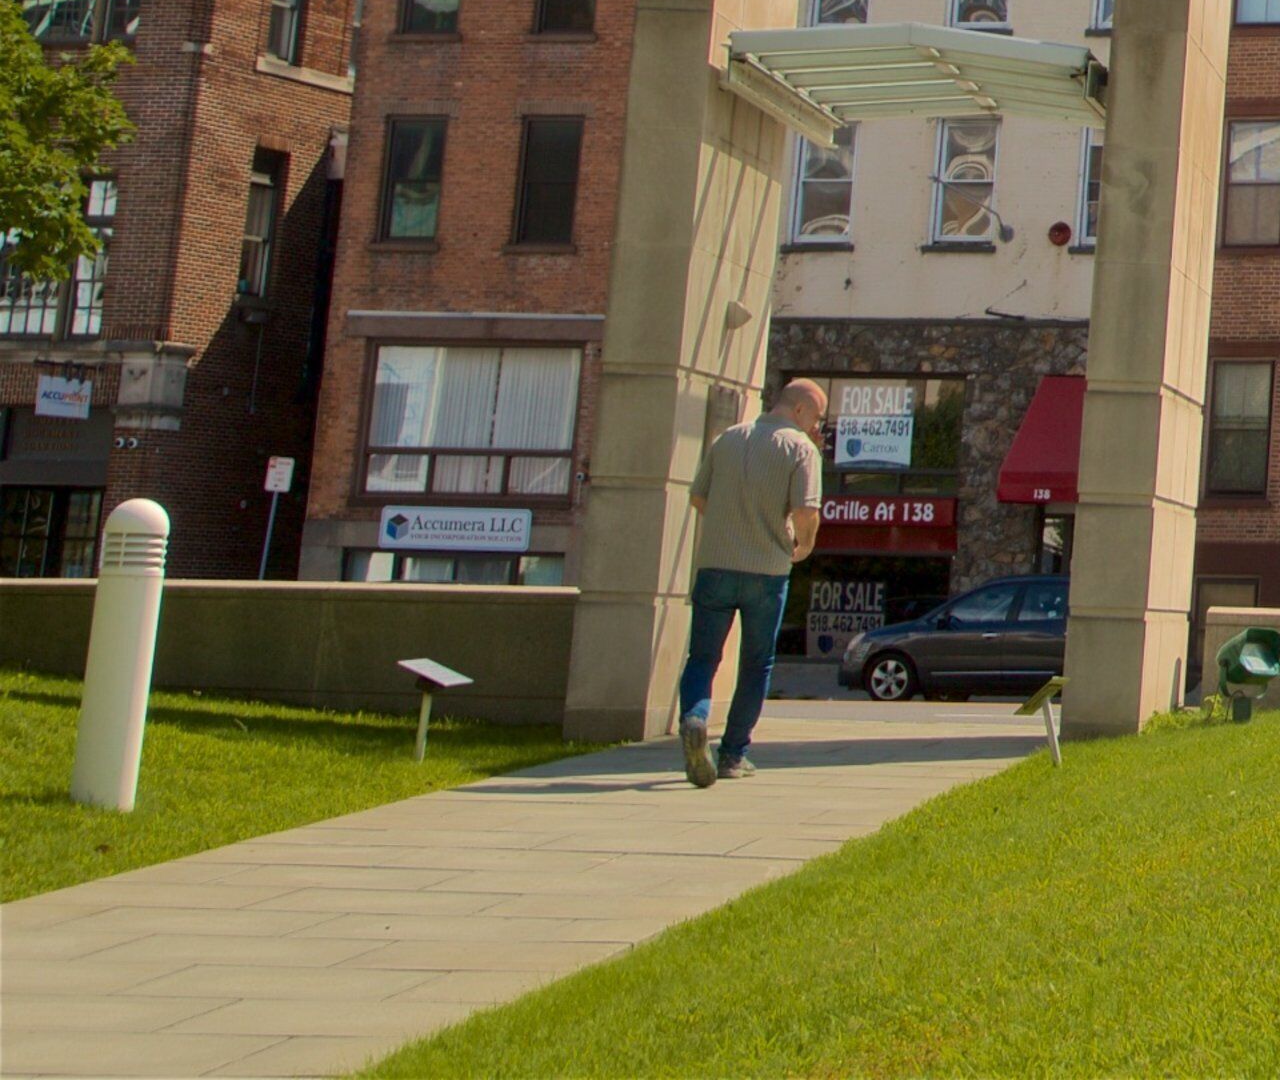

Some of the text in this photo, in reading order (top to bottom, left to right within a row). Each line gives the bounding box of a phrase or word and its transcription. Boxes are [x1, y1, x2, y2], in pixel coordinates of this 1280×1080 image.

[841, 387, 914, 415] FOR SALE
[839, 420, 909, 436] 518.462.7491
[1033, 488, 1051, 500] 138
[823, 500, 934, 522] Grille At 138
[411, 515, 522, 533] Accumera LLC
[810, 581, 884, 611] FOR SALE
